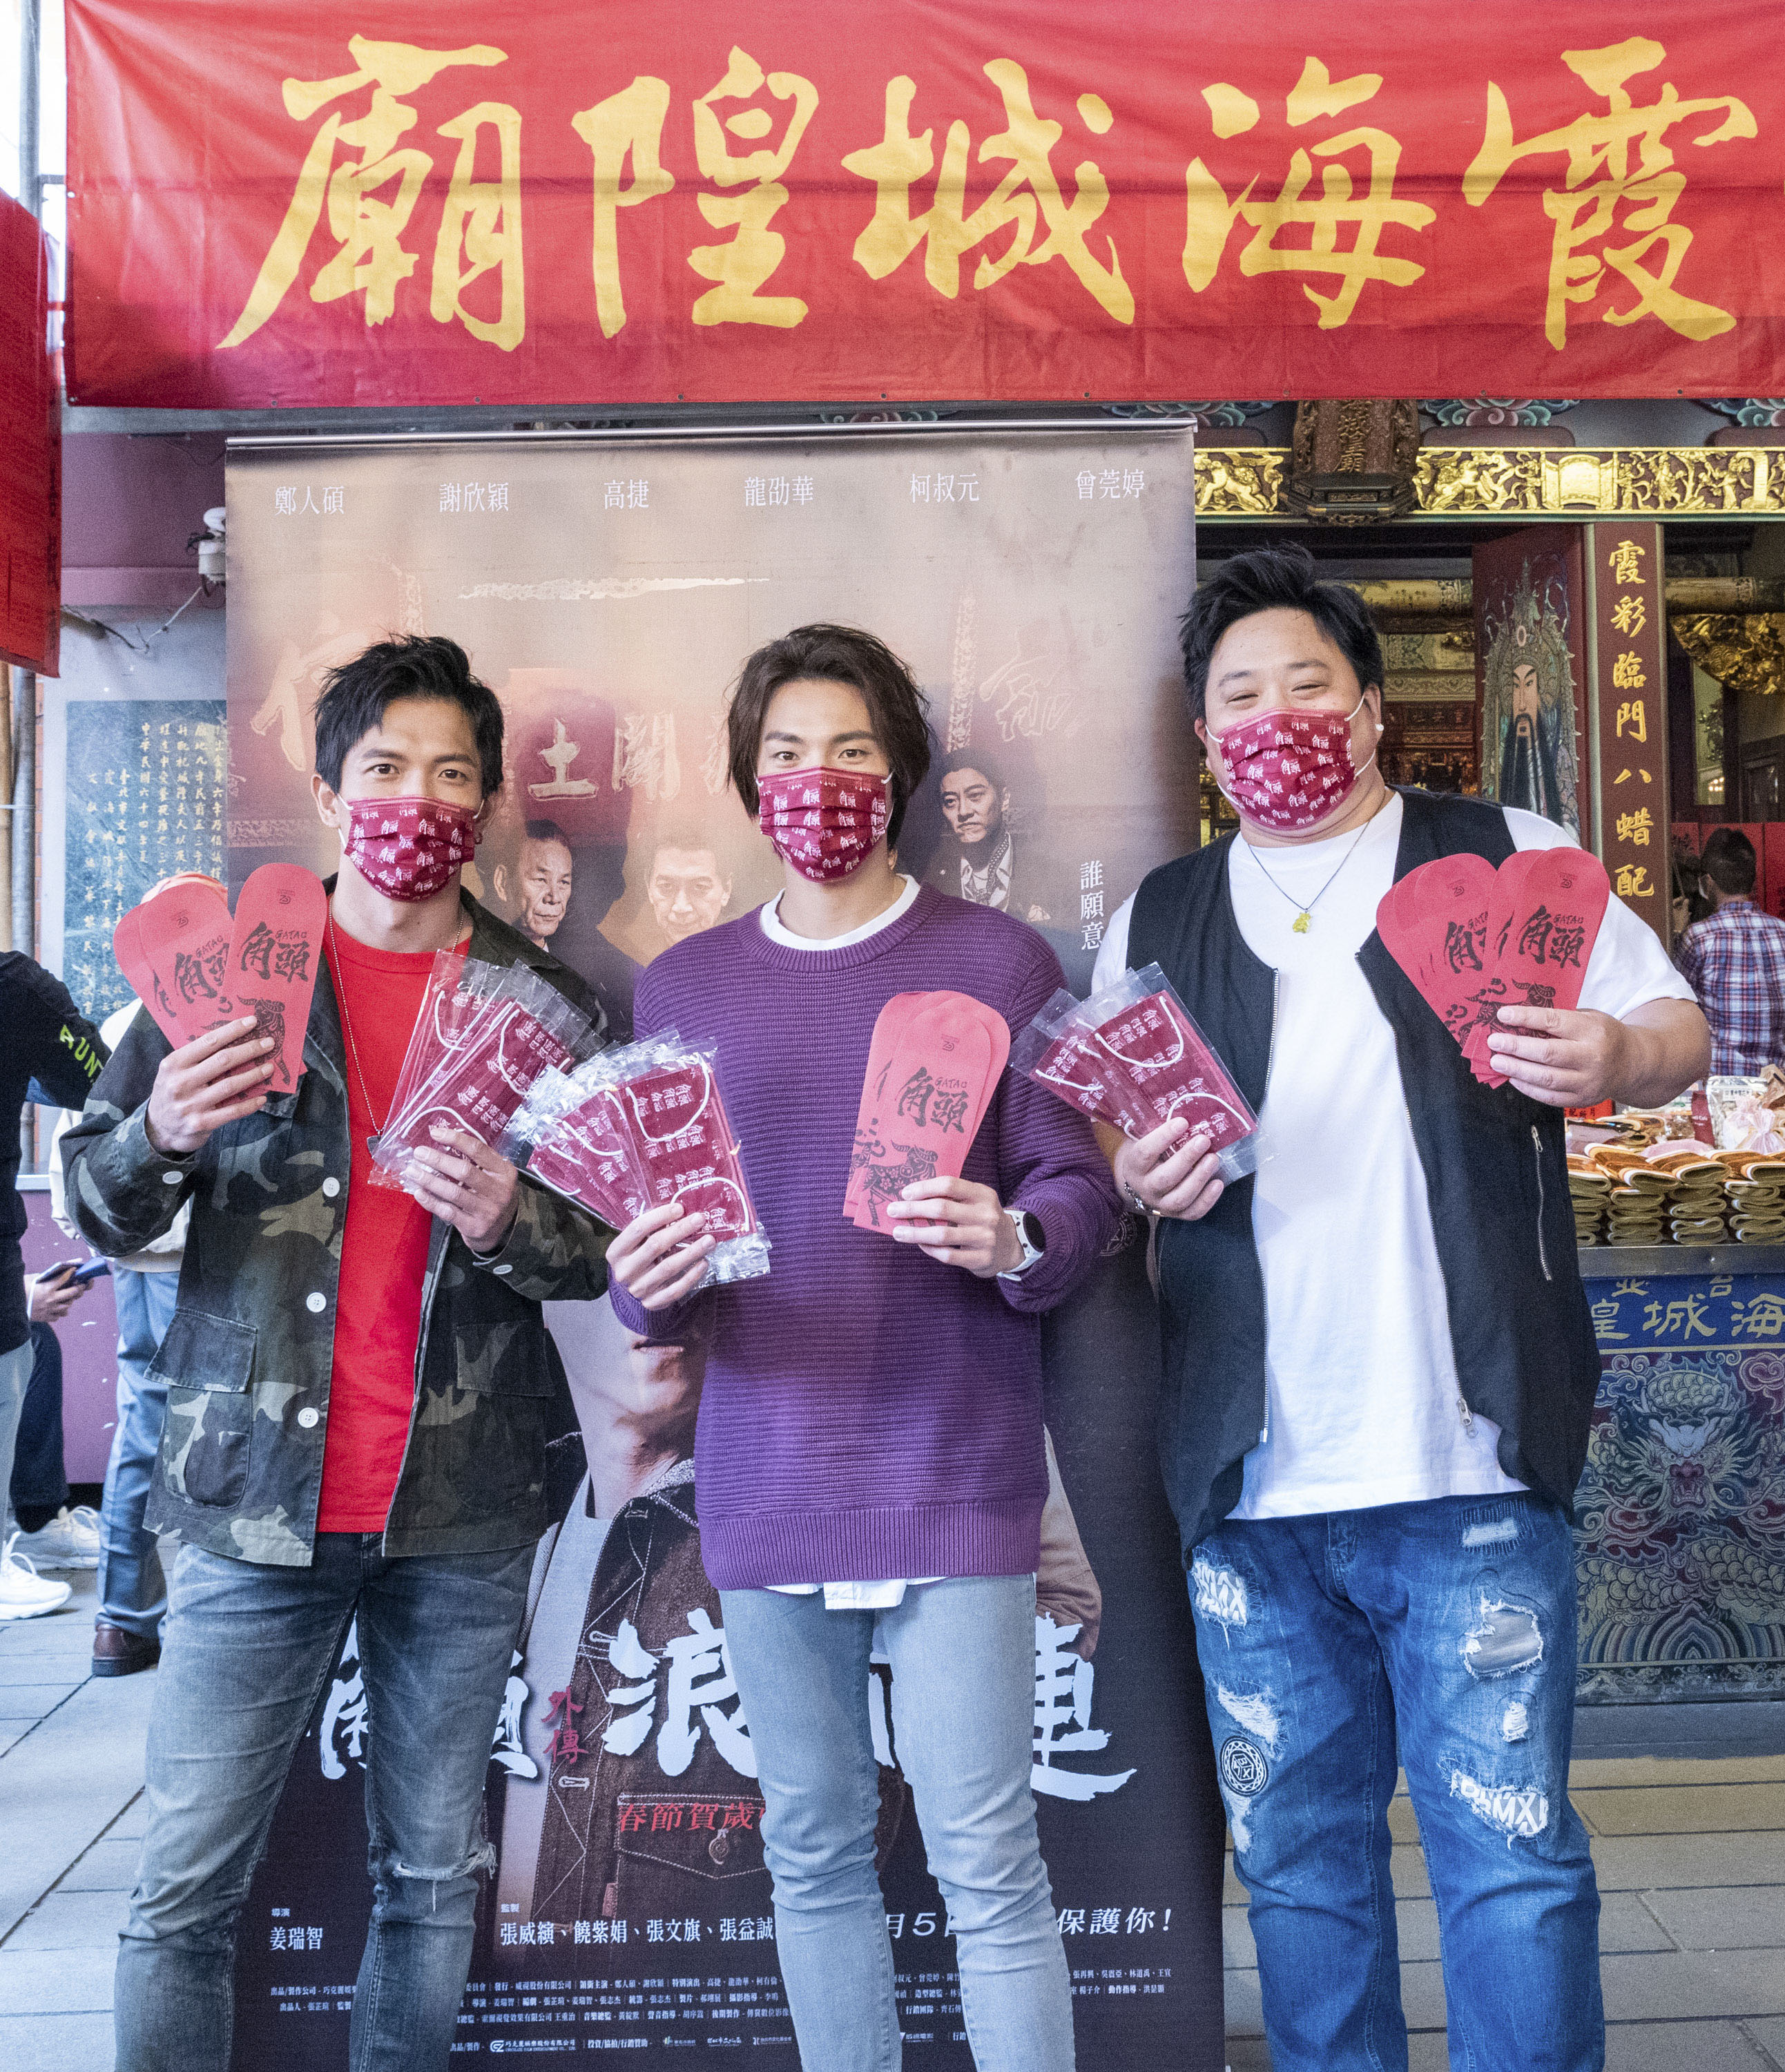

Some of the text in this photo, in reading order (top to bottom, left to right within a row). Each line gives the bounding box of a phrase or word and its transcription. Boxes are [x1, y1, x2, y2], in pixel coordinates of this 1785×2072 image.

[275, 485, 345, 516] 鄭人碩
[438, 481, 509, 513] 謝欣穎
[603, 479, 649, 510] 高捷
[744, 475, 813, 507] 龍劭華
[909, 472, 980, 503] 柯叔元
[1080, 860, 1104, 950] 誰願意
[1554, 914, 1583, 924] GATAO
[276, 930, 307, 942] GATAO
[1516, 905, 1585, 968] 角頭
[238, 921, 309, 983] 角頭
[935, 1077, 968, 1089] GATAO
[897, 1066, 969, 1133] 角頭
[541, 1686, 588, 1764] 外傳
[619, 1803, 766, 1832] 春節賀歲
[500, 1903, 519, 1912] 監製
[270, 1926, 323, 1950] 姜瑞智
